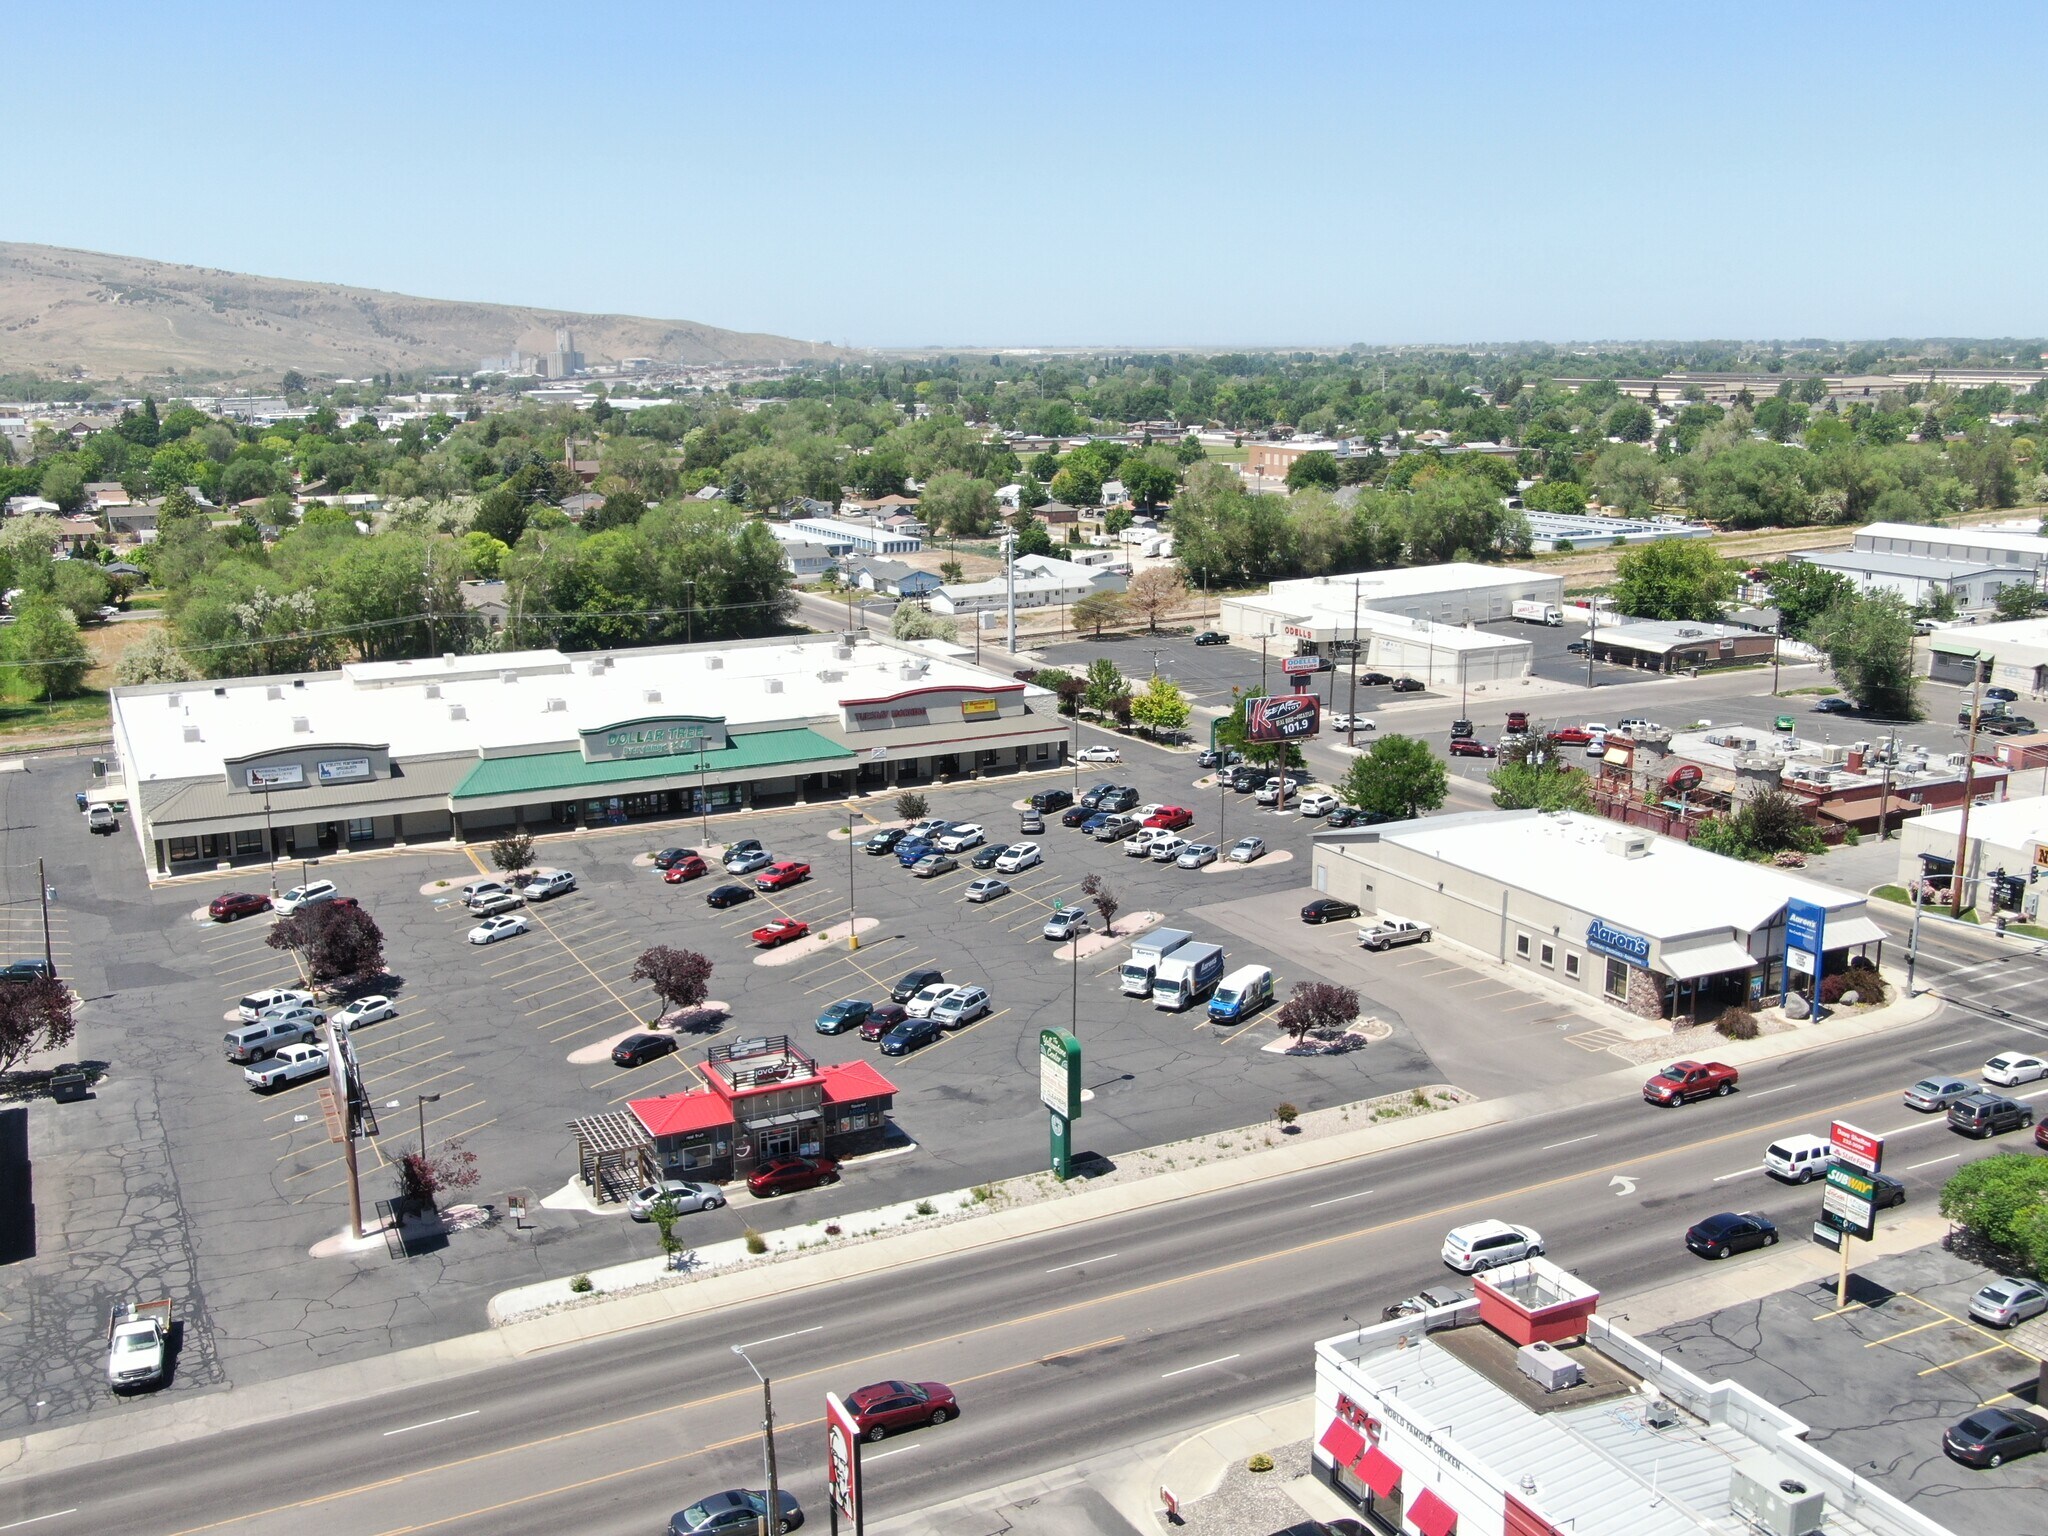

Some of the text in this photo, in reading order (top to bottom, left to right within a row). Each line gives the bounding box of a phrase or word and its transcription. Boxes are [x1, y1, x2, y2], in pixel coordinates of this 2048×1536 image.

[1285, 626, 1312, 639] ODELLS
[1287, 657, 1317, 665] ODELLS
[1283, 720, 1309, 735] 101.9
[607, 726, 704, 746] DOLLAR TREE
[1789, 913, 1816, 928] Aaron's
[1586, 919, 1646, 956] Aaron's
[1047, 1047, 1062, 1063] Center
[755, 1067, 774, 1079] java
[1827, 1170, 1872, 1194] SUBWAY
[1335, 1392, 1382, 1442] KFC
[1382, 1404, 1461, 1471] WORLD FAMOUS CHICKEN
